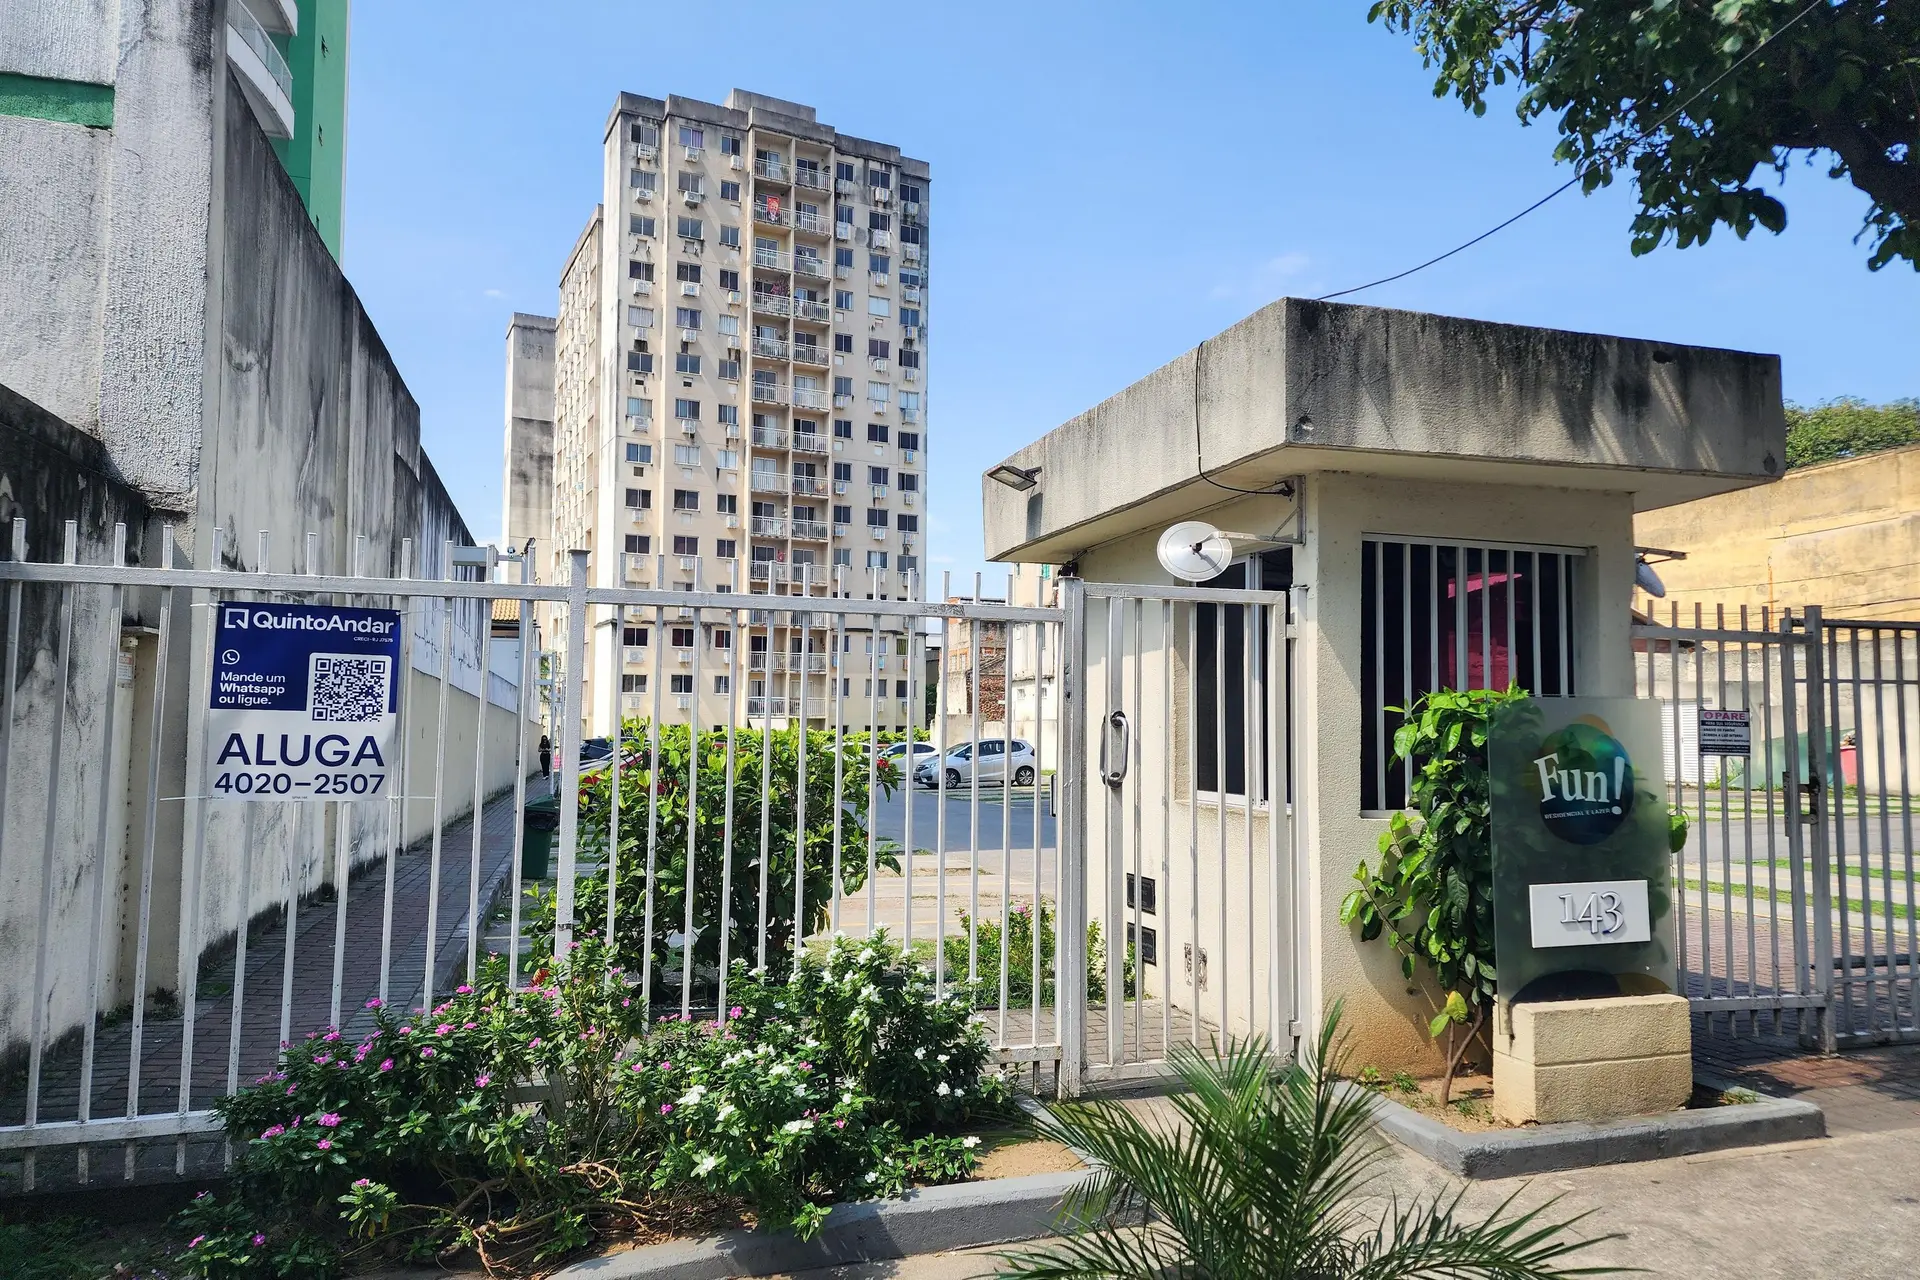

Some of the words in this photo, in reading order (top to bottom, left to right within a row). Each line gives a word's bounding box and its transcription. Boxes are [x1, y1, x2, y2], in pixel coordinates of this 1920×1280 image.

[253, 611, 394, 634] QuintoAndar
[220, 671, 263, 682] Mande
[266, 675, 286, 683] um
[219, 682, 285, 696] Whatsapp
[218, 696, 235, 704] ou
[238, 694, 272, 707] ligue.
[1715, 712, 1745, 720] PARE
[216, 733, 385, 767] ALUGA
[214, 773, 385, 794] 4020-2507
[1534, 753, 1625, 815] Fun!
[1544, 810, 1584, 819] RESIDENCIAL
[1559, 890, 1625, 935] 143
